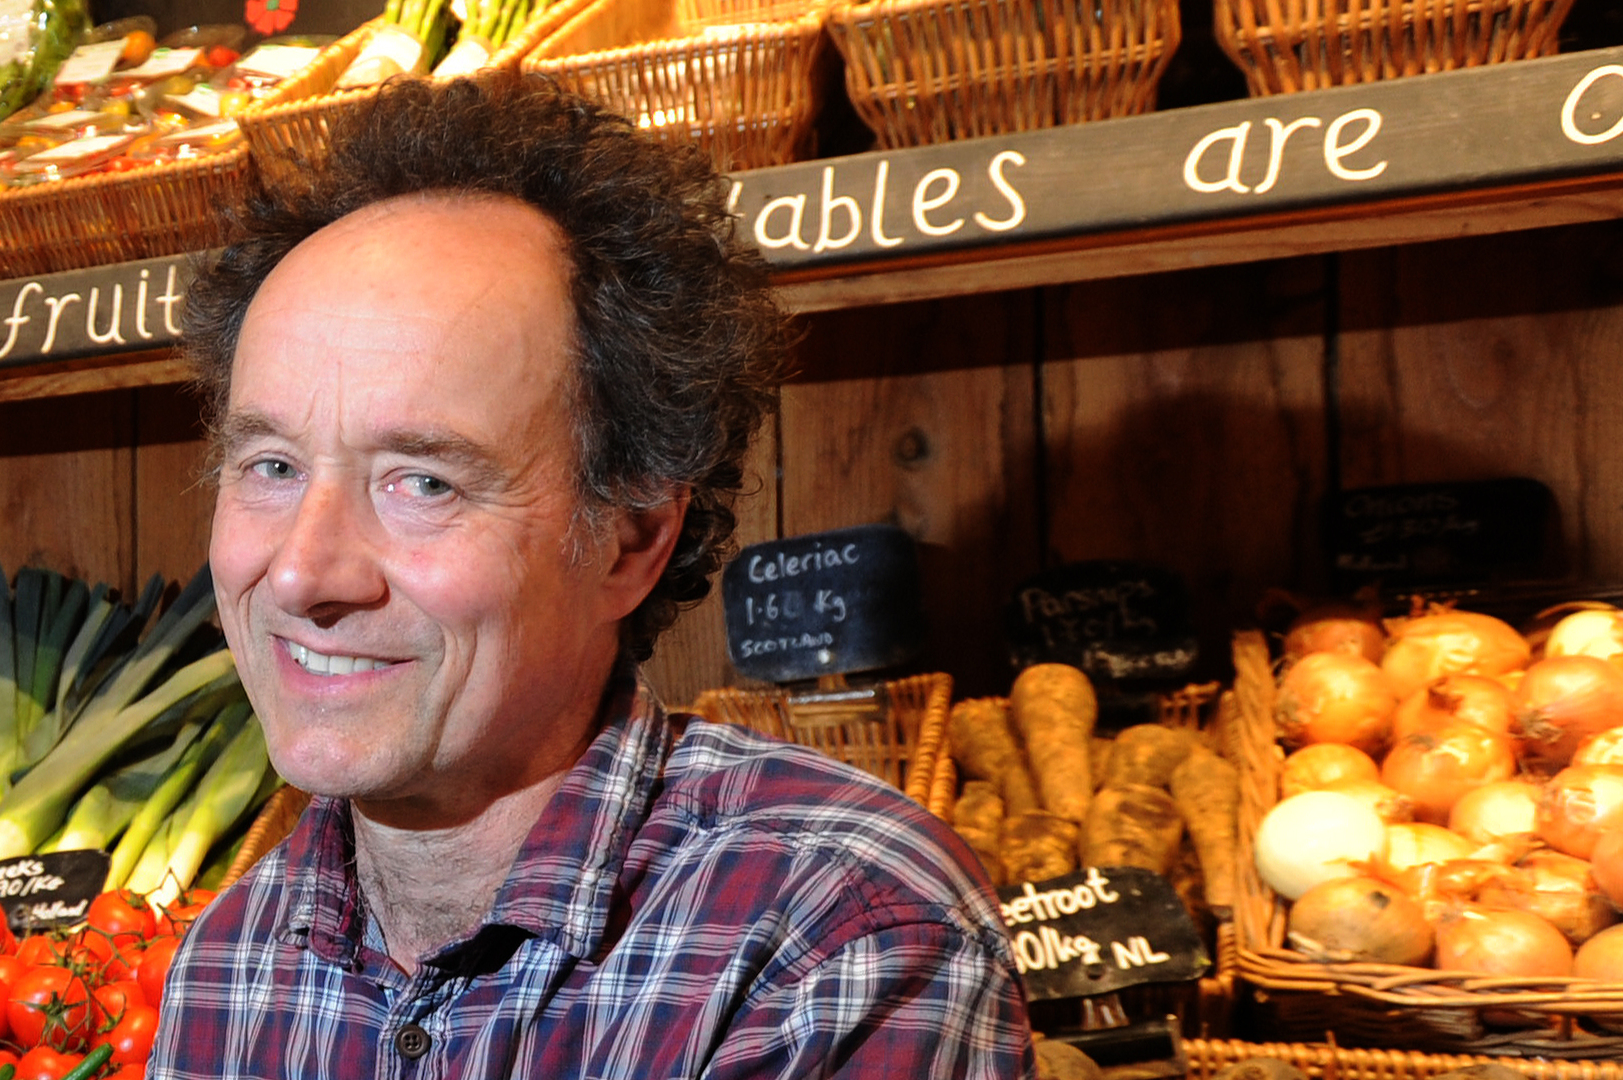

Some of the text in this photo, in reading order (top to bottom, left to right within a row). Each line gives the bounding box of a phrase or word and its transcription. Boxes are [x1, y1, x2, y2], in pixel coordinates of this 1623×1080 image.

[1183, 108, 1388, 195] are
[748, 541, 860, 584] Celeriac
[1110, 936, 1171, 970] NL
